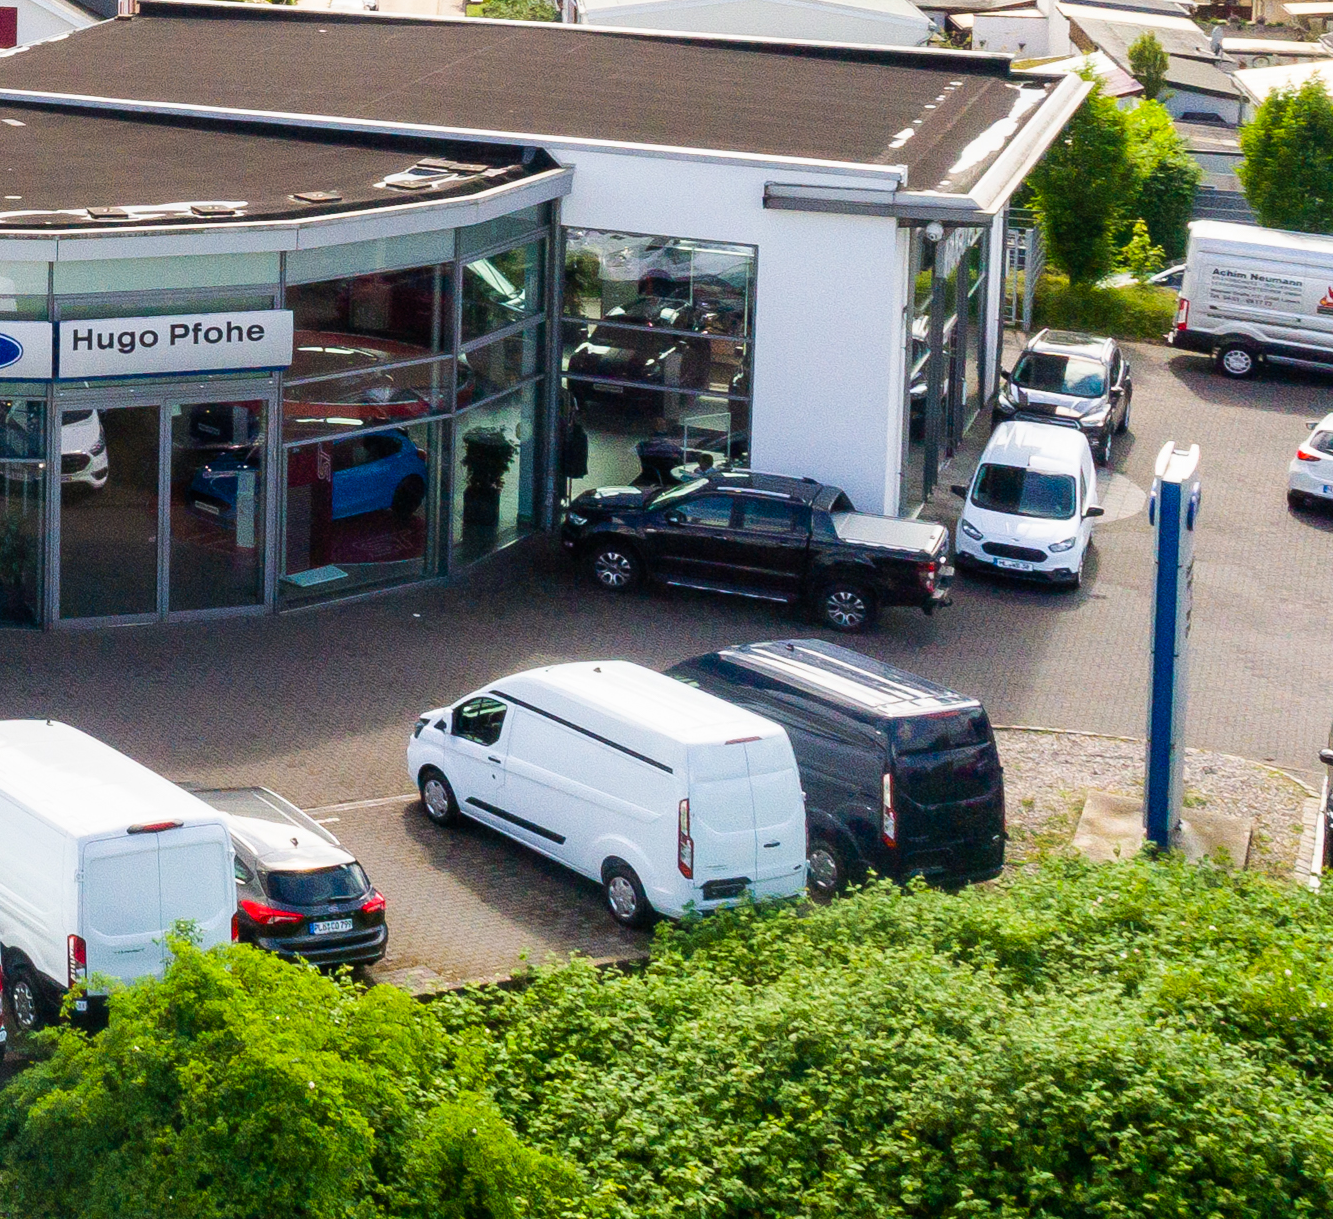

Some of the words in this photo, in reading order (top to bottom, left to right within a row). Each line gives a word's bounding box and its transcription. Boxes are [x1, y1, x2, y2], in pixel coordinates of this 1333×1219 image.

[1212, 267, 1247, 280] Achim
[1250, 273, 1303, 287] Neumann
[72, 328, 159, 355] Hugo
[169, 321, 265, 346] Pfohe
